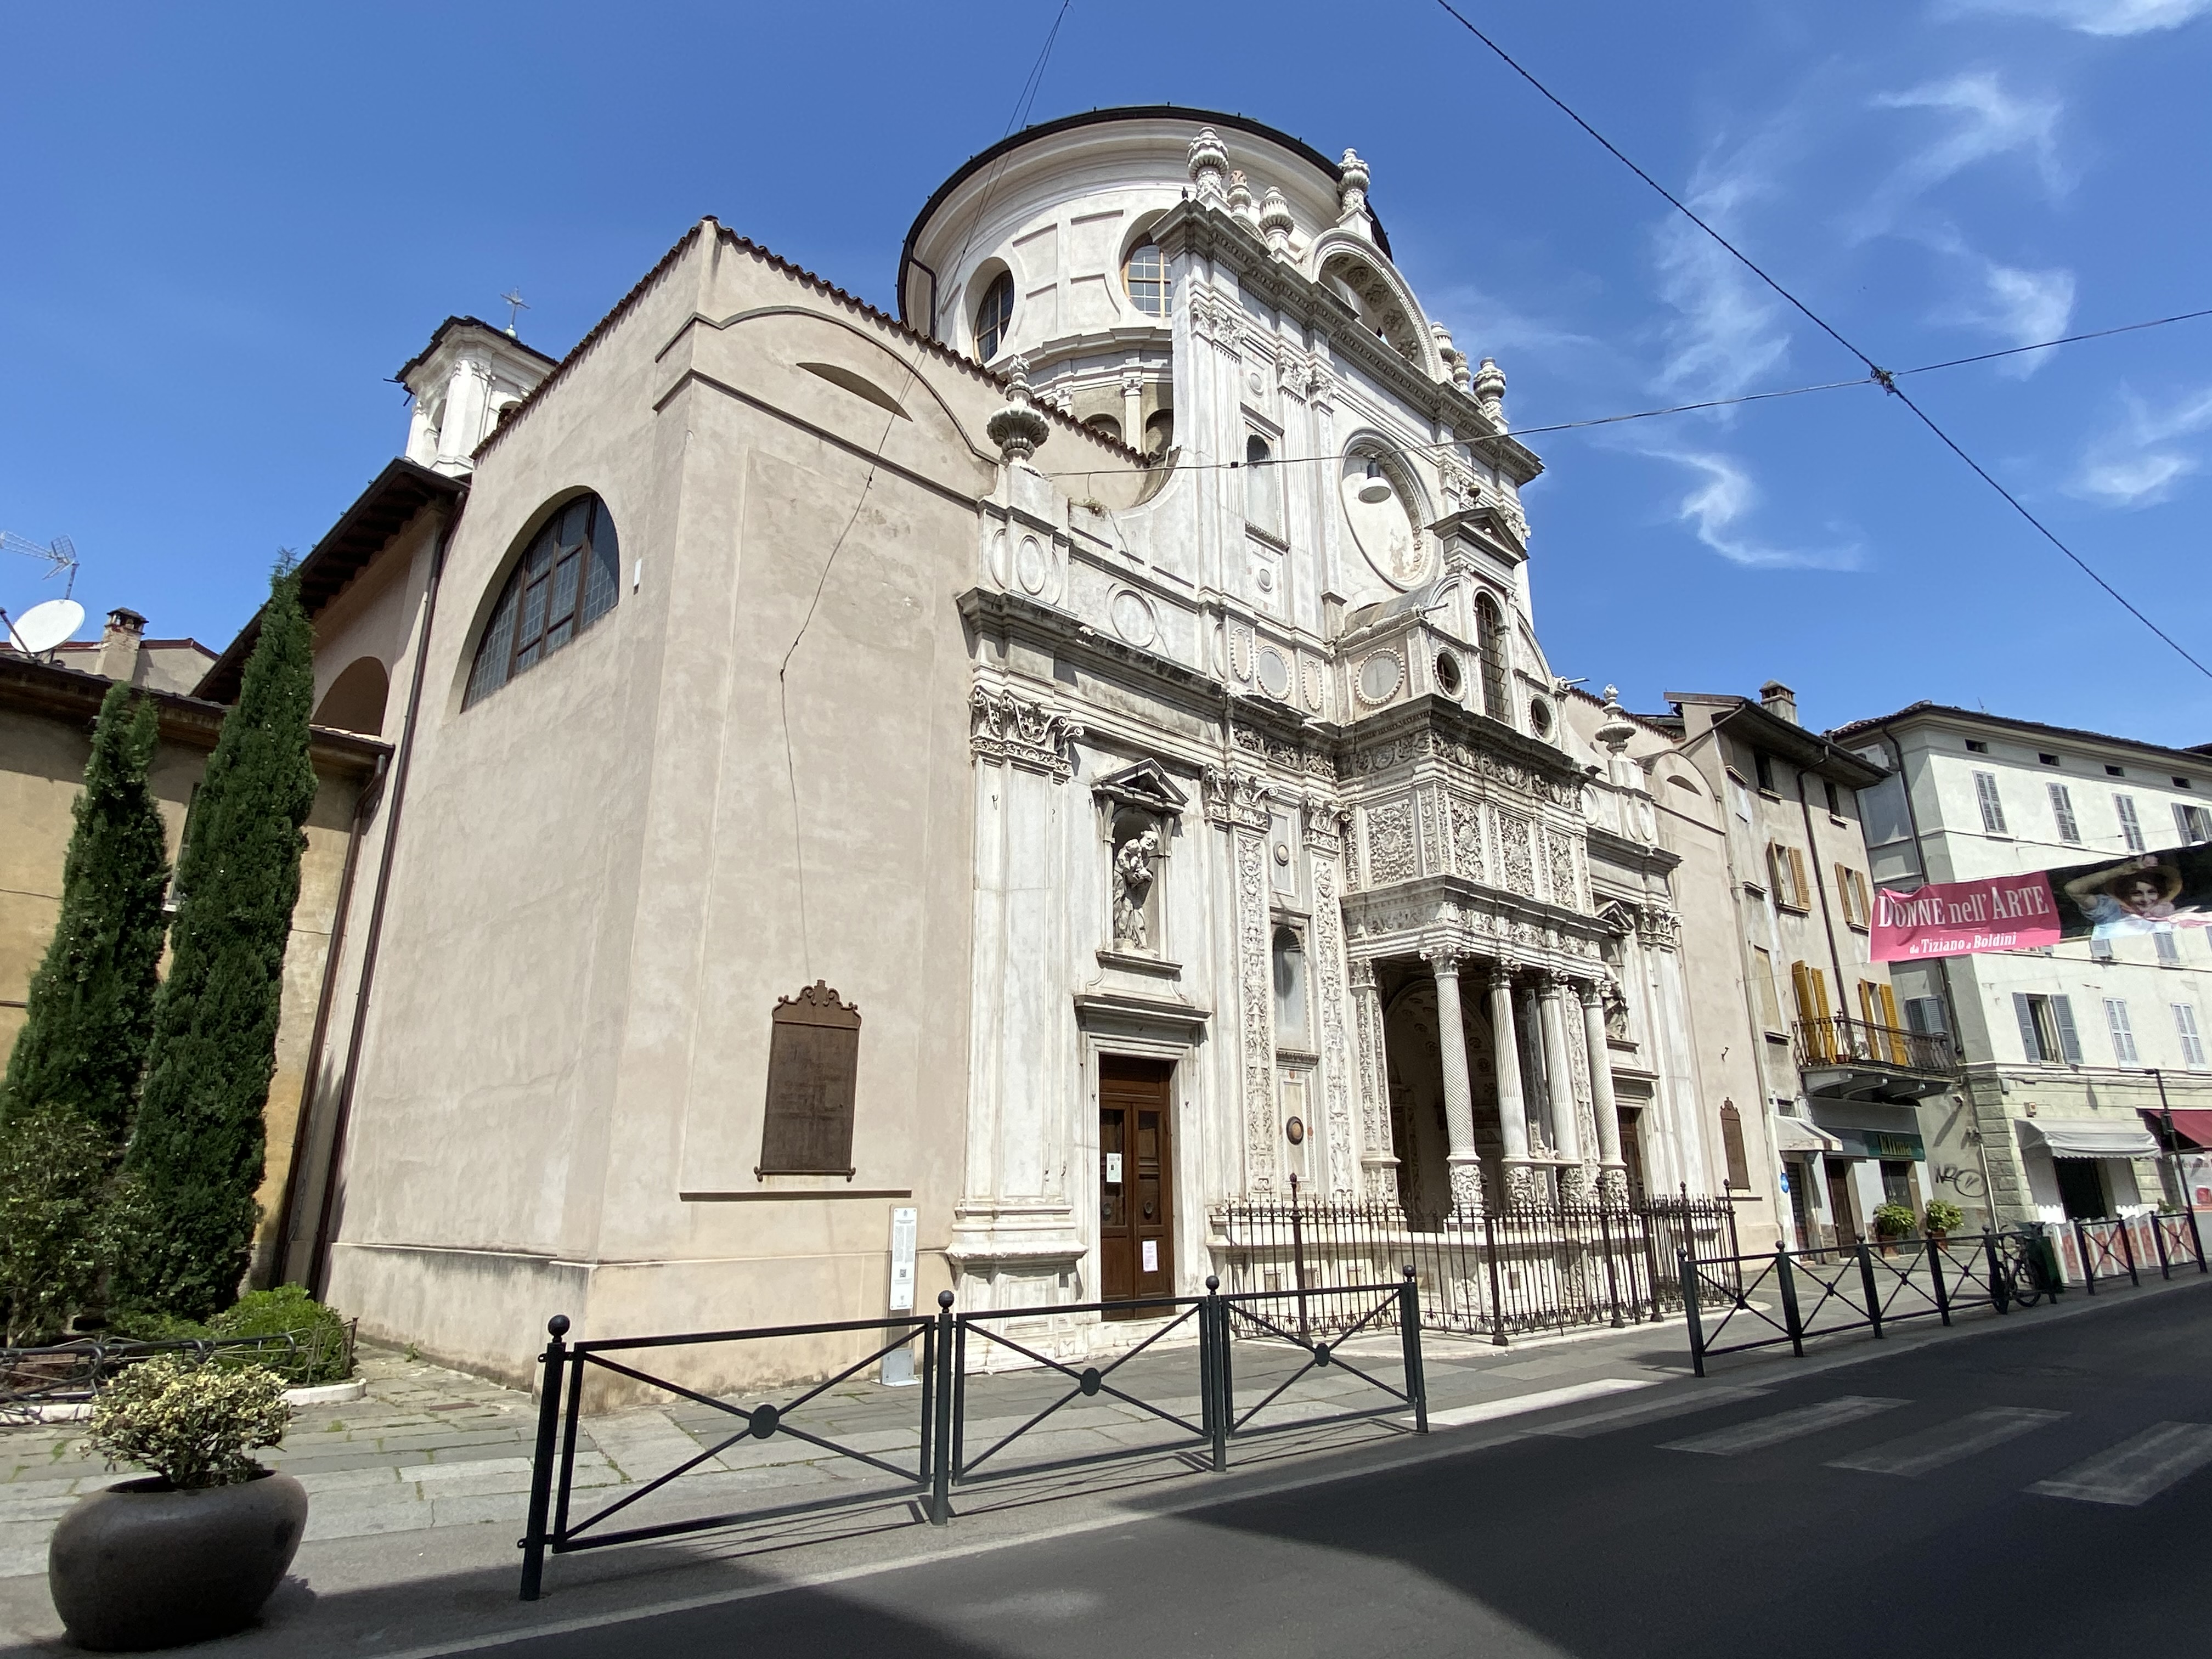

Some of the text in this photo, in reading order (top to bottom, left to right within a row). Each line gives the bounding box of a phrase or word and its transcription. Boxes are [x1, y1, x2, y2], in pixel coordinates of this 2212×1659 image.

[1878, 895, 1946, 927] DONNE
[1992, 885, 2050, 920] ARTE
[1909, 944, 1919, 954] da
[1921, 937, 1965, 953] Tiziano
[1973, 931, 2017, 949] Boldini
